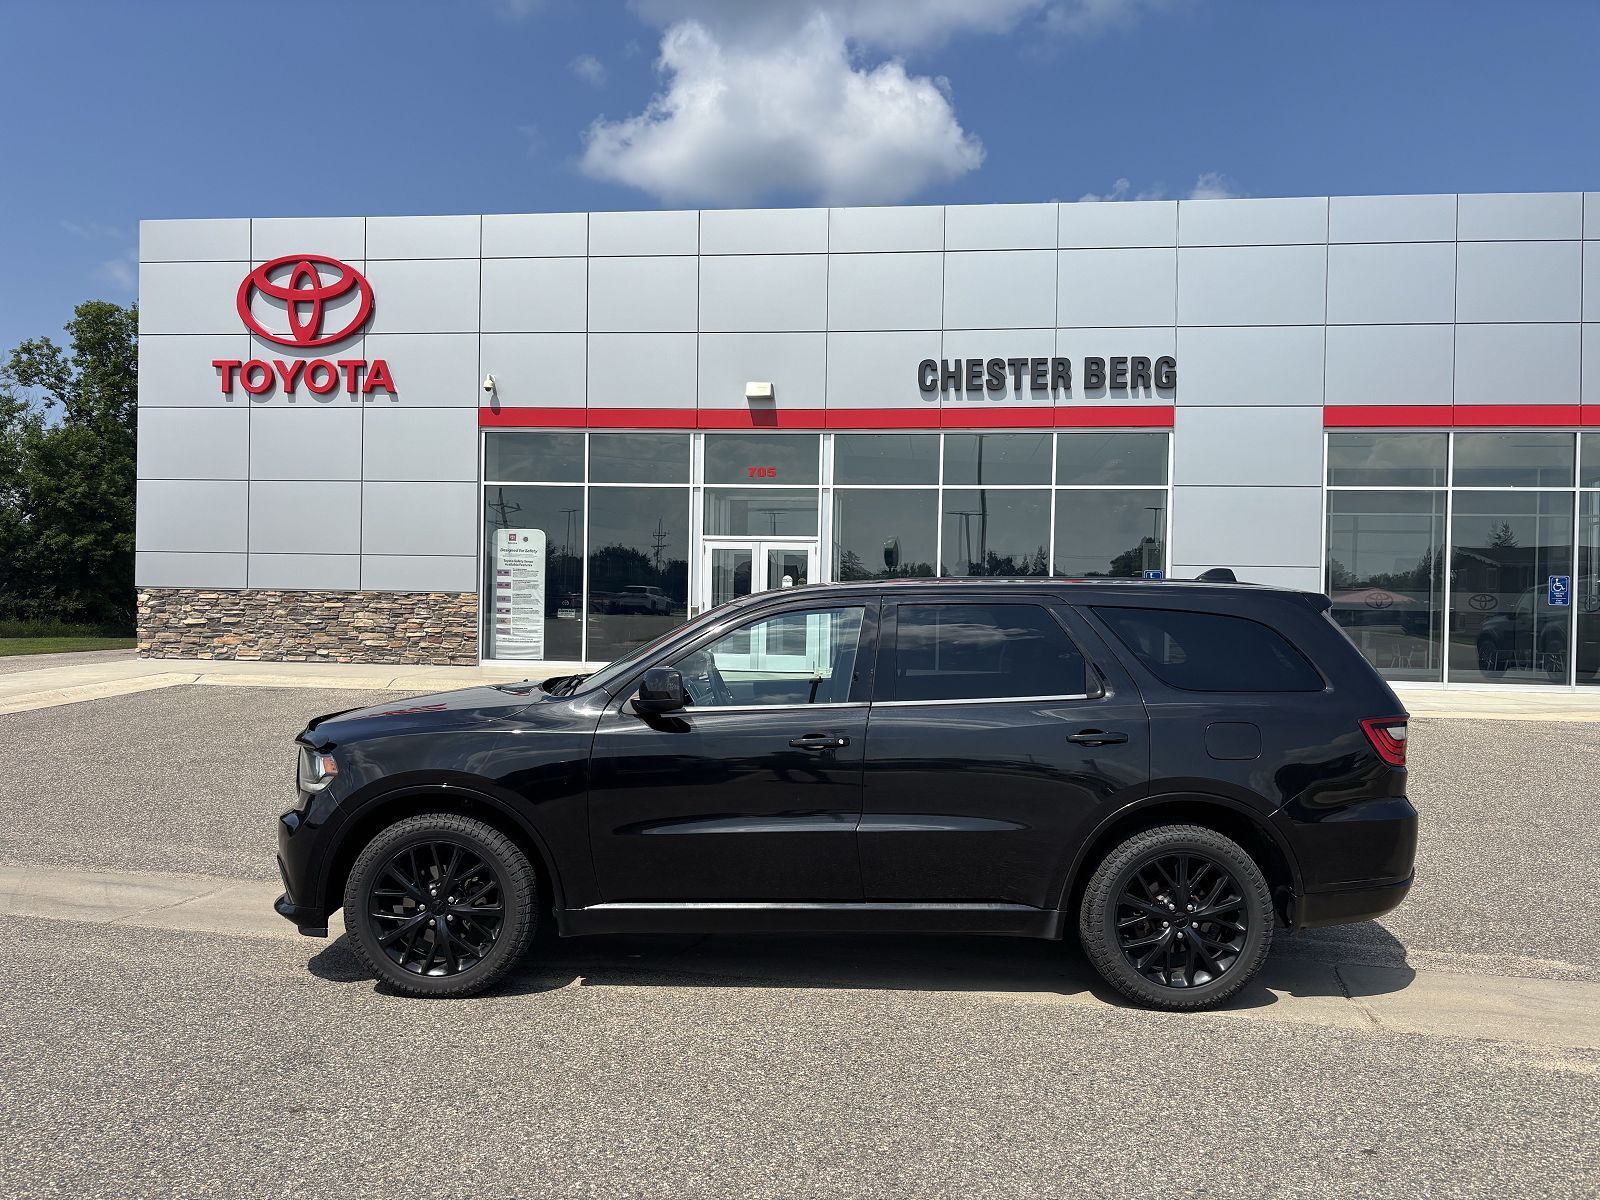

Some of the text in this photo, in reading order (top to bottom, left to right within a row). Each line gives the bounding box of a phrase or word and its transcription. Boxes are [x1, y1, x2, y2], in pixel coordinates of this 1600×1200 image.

[212, 359, 396, 394] TOYOTA
[918, 356, 1177, 391] CHESTER BERG
[747, 466, 777, 478] 705
